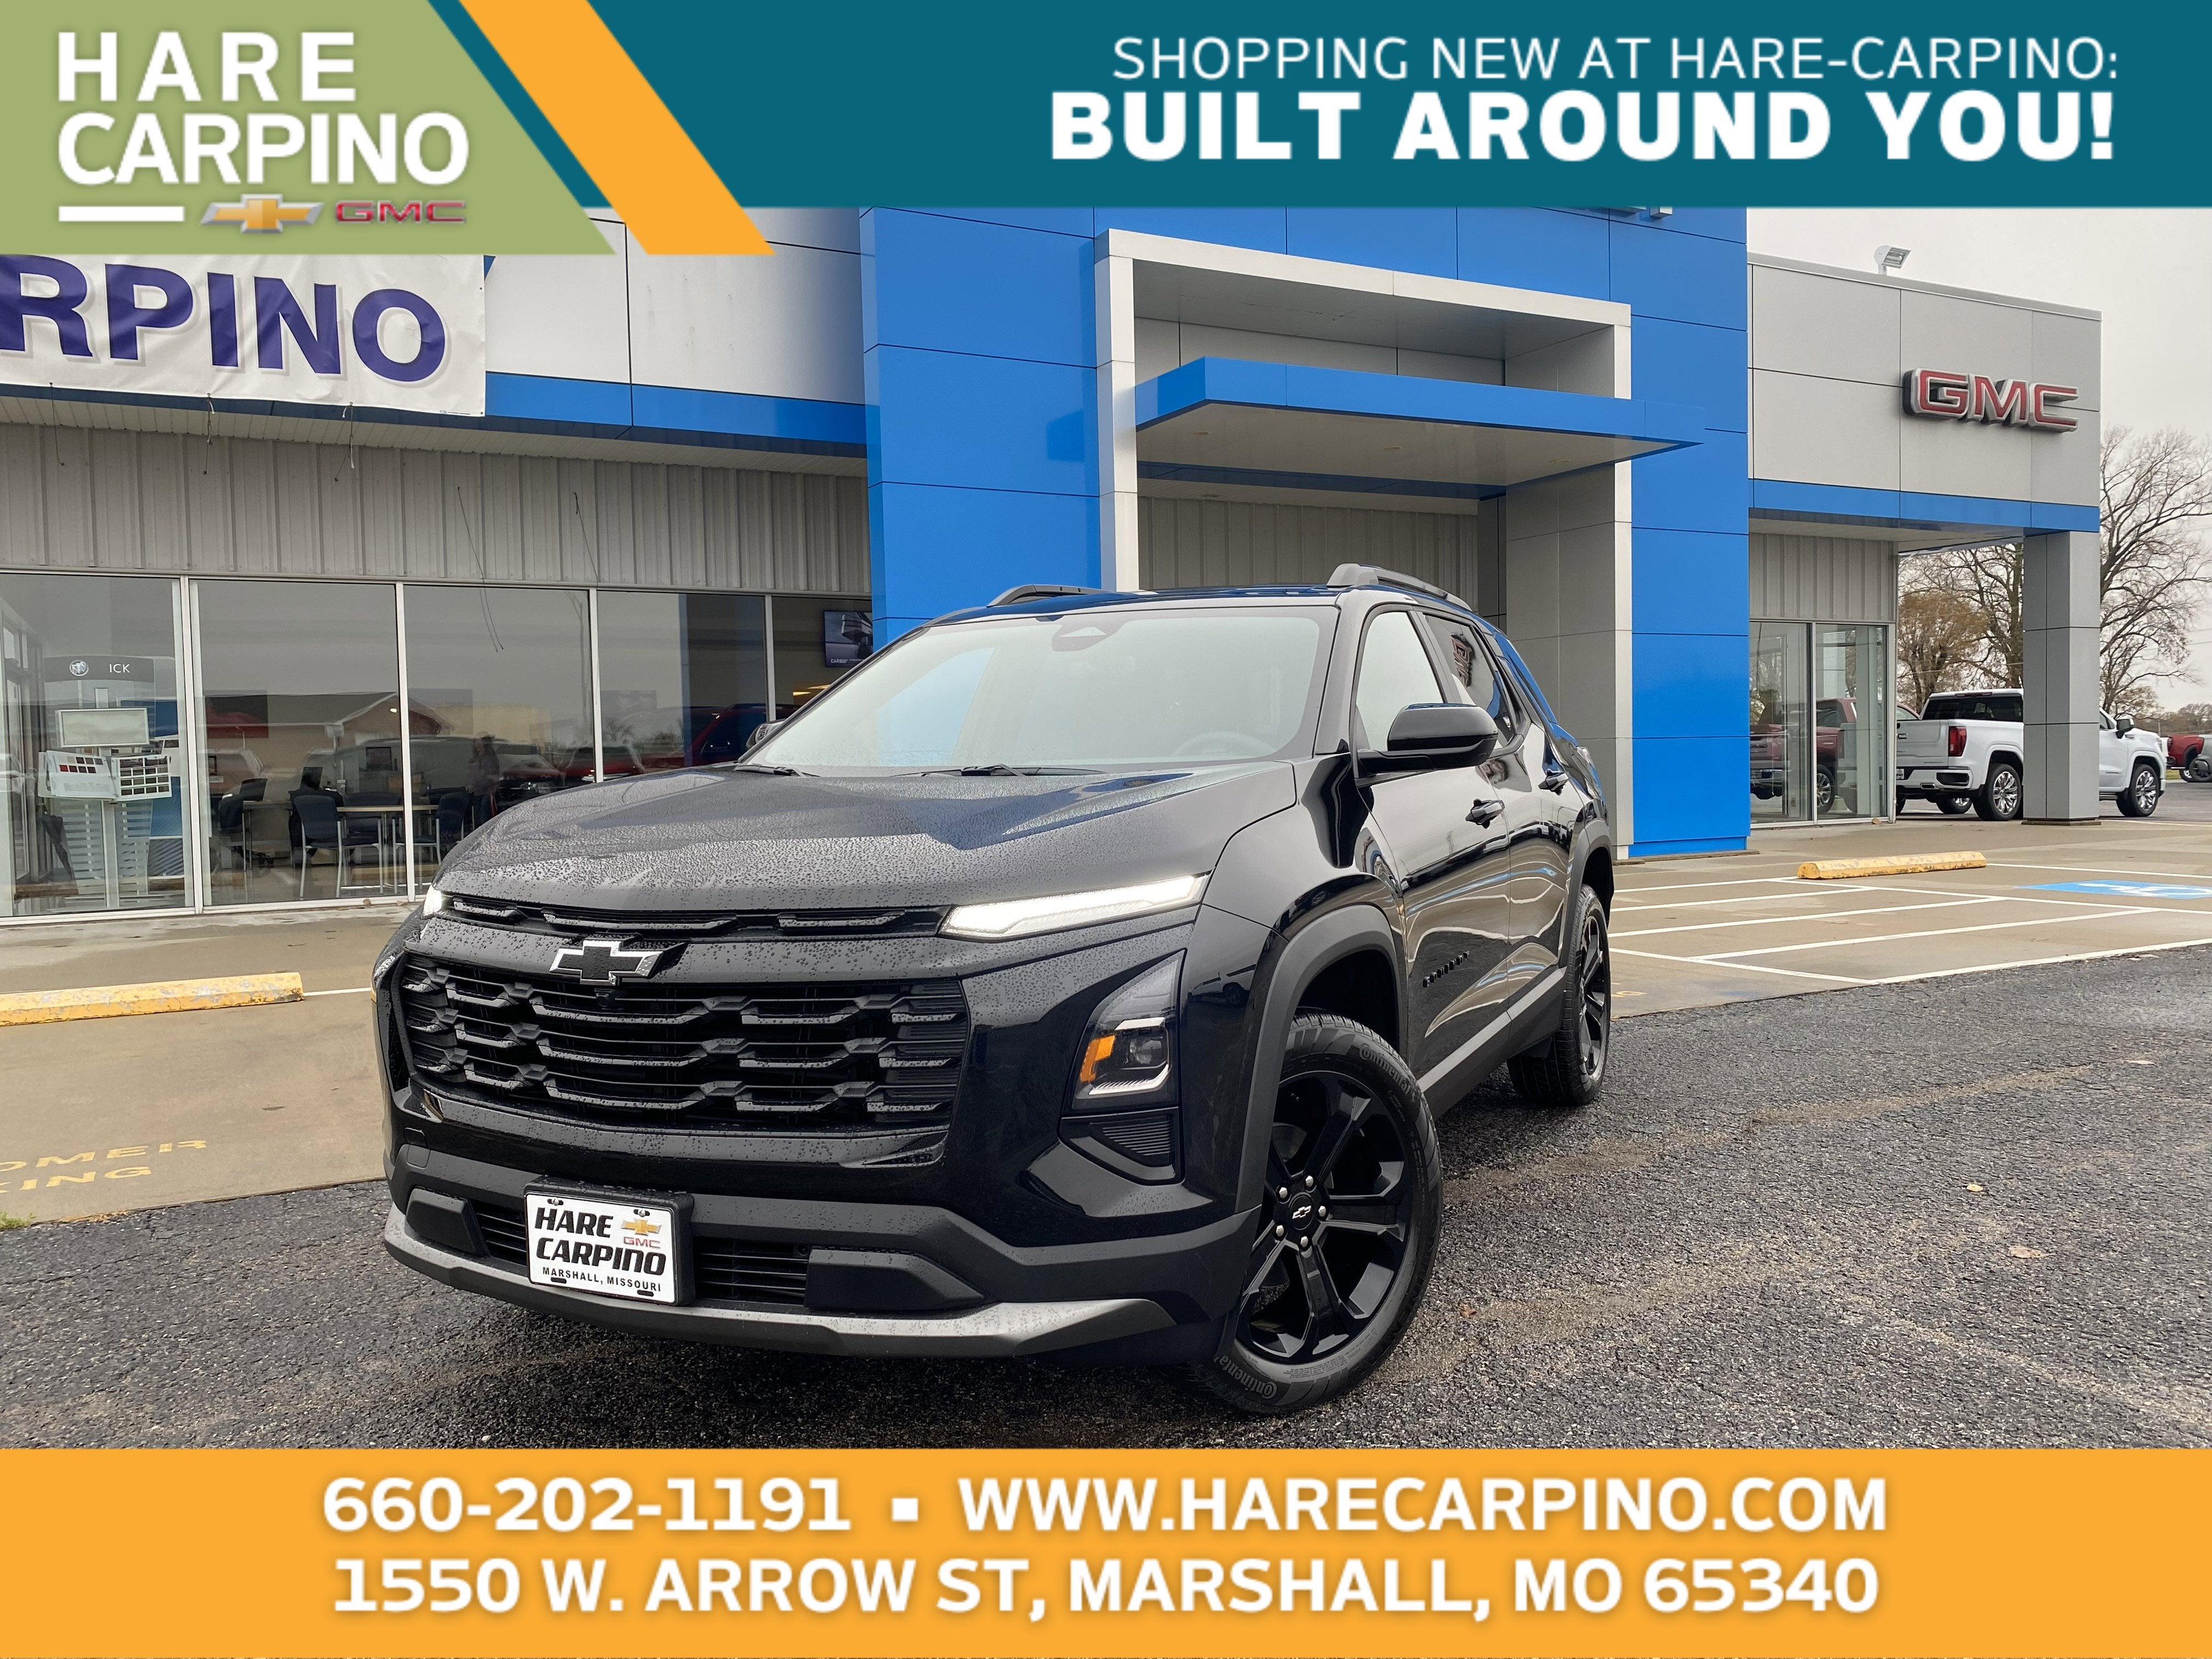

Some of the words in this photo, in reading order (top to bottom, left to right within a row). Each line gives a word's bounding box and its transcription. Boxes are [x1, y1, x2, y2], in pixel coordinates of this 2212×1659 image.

[1907, 368, 2079, 432] GMC
[0, 1166, 152, 1194] ING
[534, 1207, 614, 1238] HARE
[536, 1237, 667, 1276] CARPINO
[623, 1236, 661, 1249] GMC
[543, 1266, 603, 1285] MARSHALL,
[607, 1276, 662, 1292] MISSOURI
